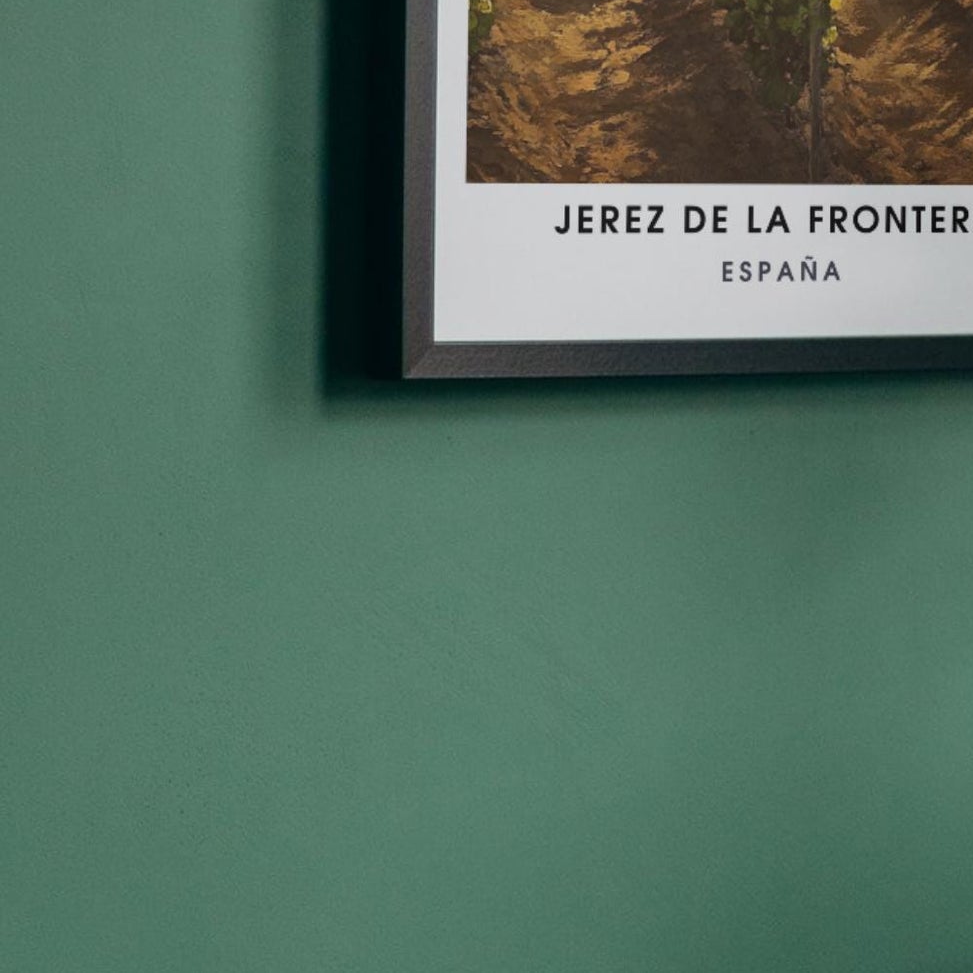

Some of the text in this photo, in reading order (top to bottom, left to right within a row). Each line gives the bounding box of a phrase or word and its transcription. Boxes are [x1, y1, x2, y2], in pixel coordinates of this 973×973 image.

[554, 205, 665, 235] JEREZ
[683, 205, 728, 234] DE
[747, 205, 791, 234] LA
[722, 255, 841, 283] ESPAÑA
